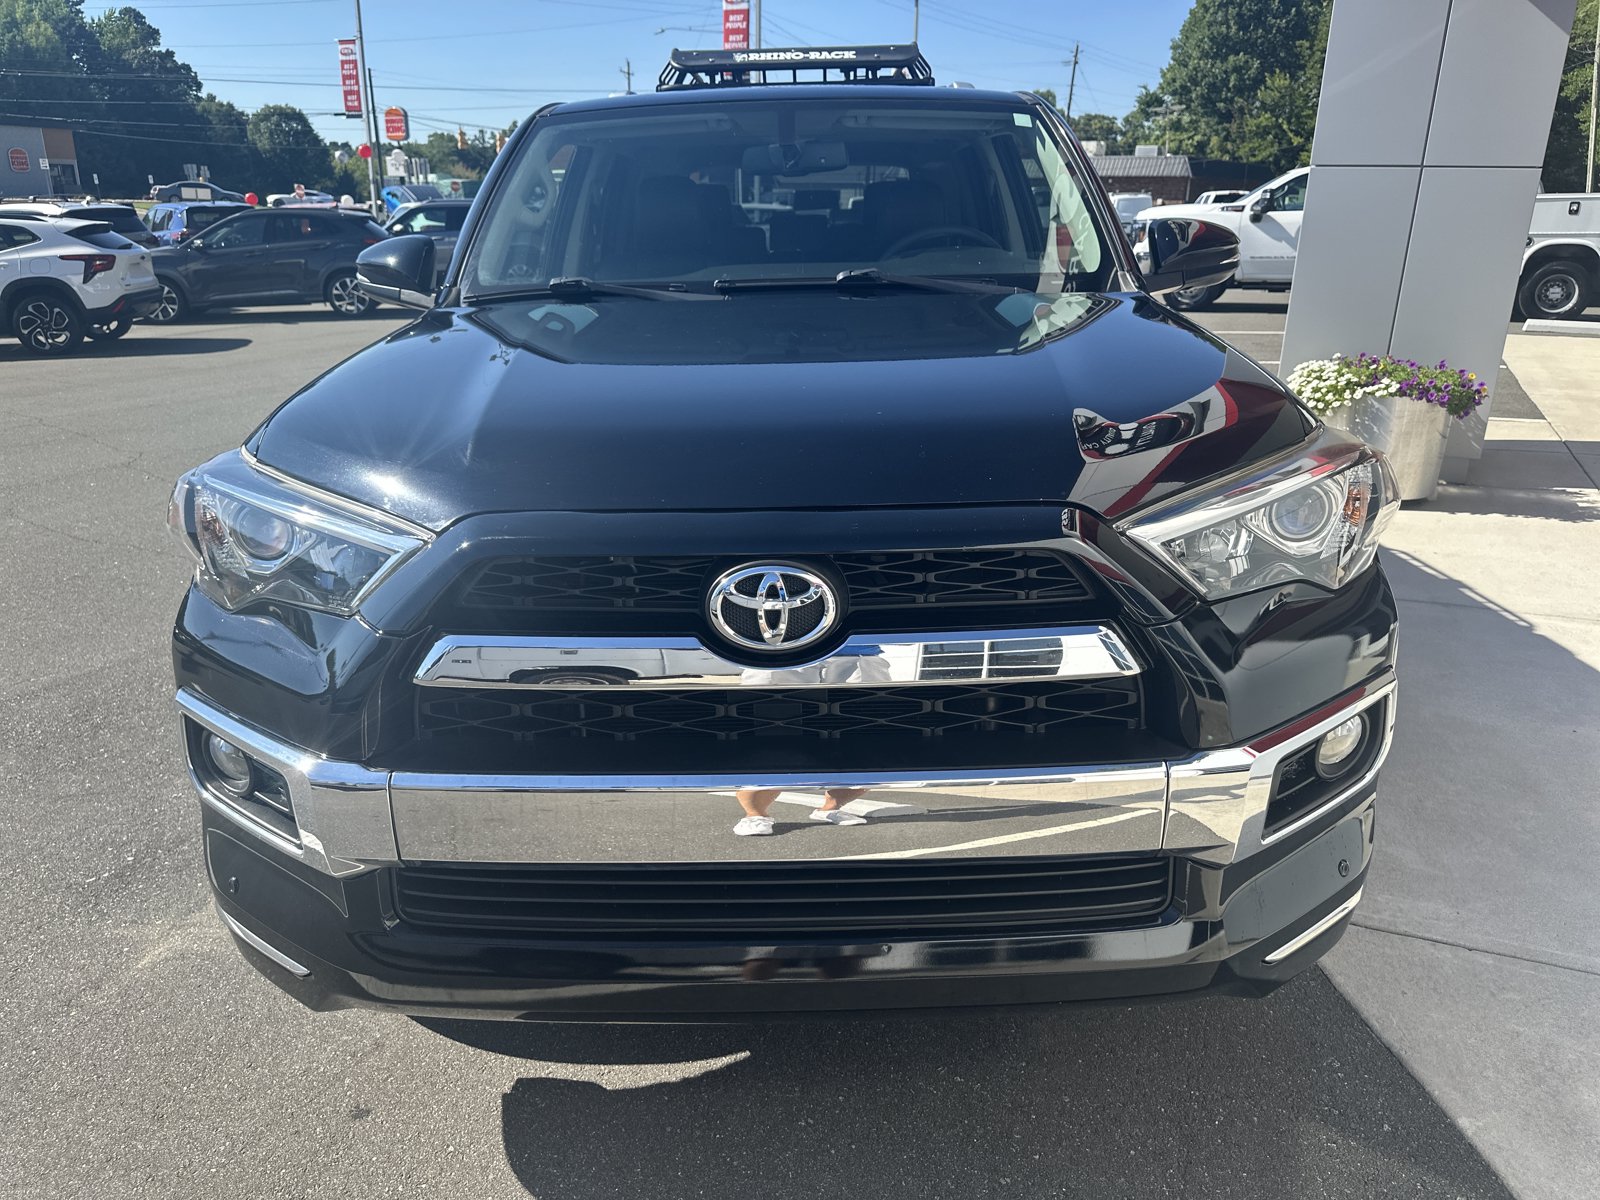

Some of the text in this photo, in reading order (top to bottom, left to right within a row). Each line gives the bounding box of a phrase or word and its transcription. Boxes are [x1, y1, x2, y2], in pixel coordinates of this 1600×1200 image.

[725, 21, 748, 29] PEOPLE
[728, 34, 744, 42] BEST
[748, 51, 856, 60] RHINO-RACK
